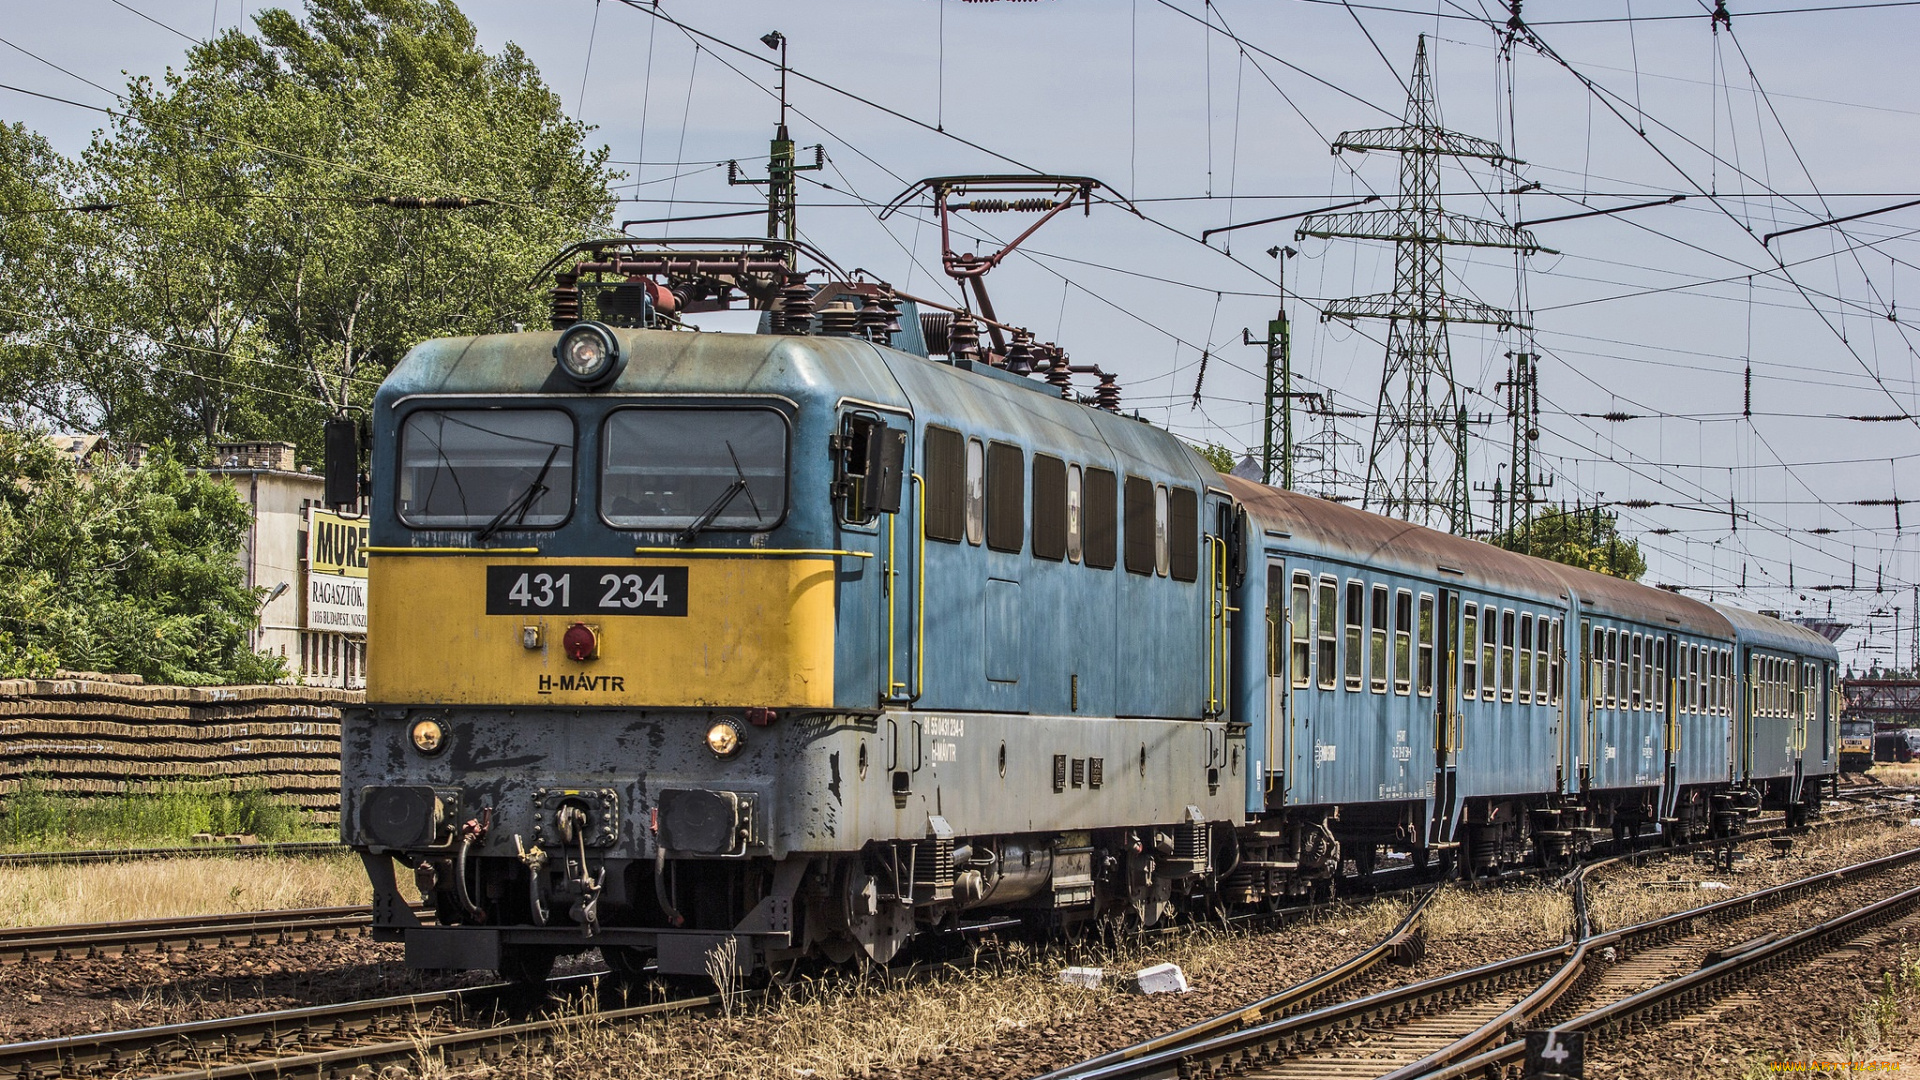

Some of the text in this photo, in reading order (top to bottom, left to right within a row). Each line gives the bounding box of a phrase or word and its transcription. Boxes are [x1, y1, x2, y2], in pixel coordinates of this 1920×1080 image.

[312, 581, 365, 610] RAGASZTÓK,
[509, 573, 668, 608] 431 234
[538, 672, 625, 694] H-MÁVTR
[931, 716, 938, 736] 55
[1541, 1032, 1569, 1064] 4
